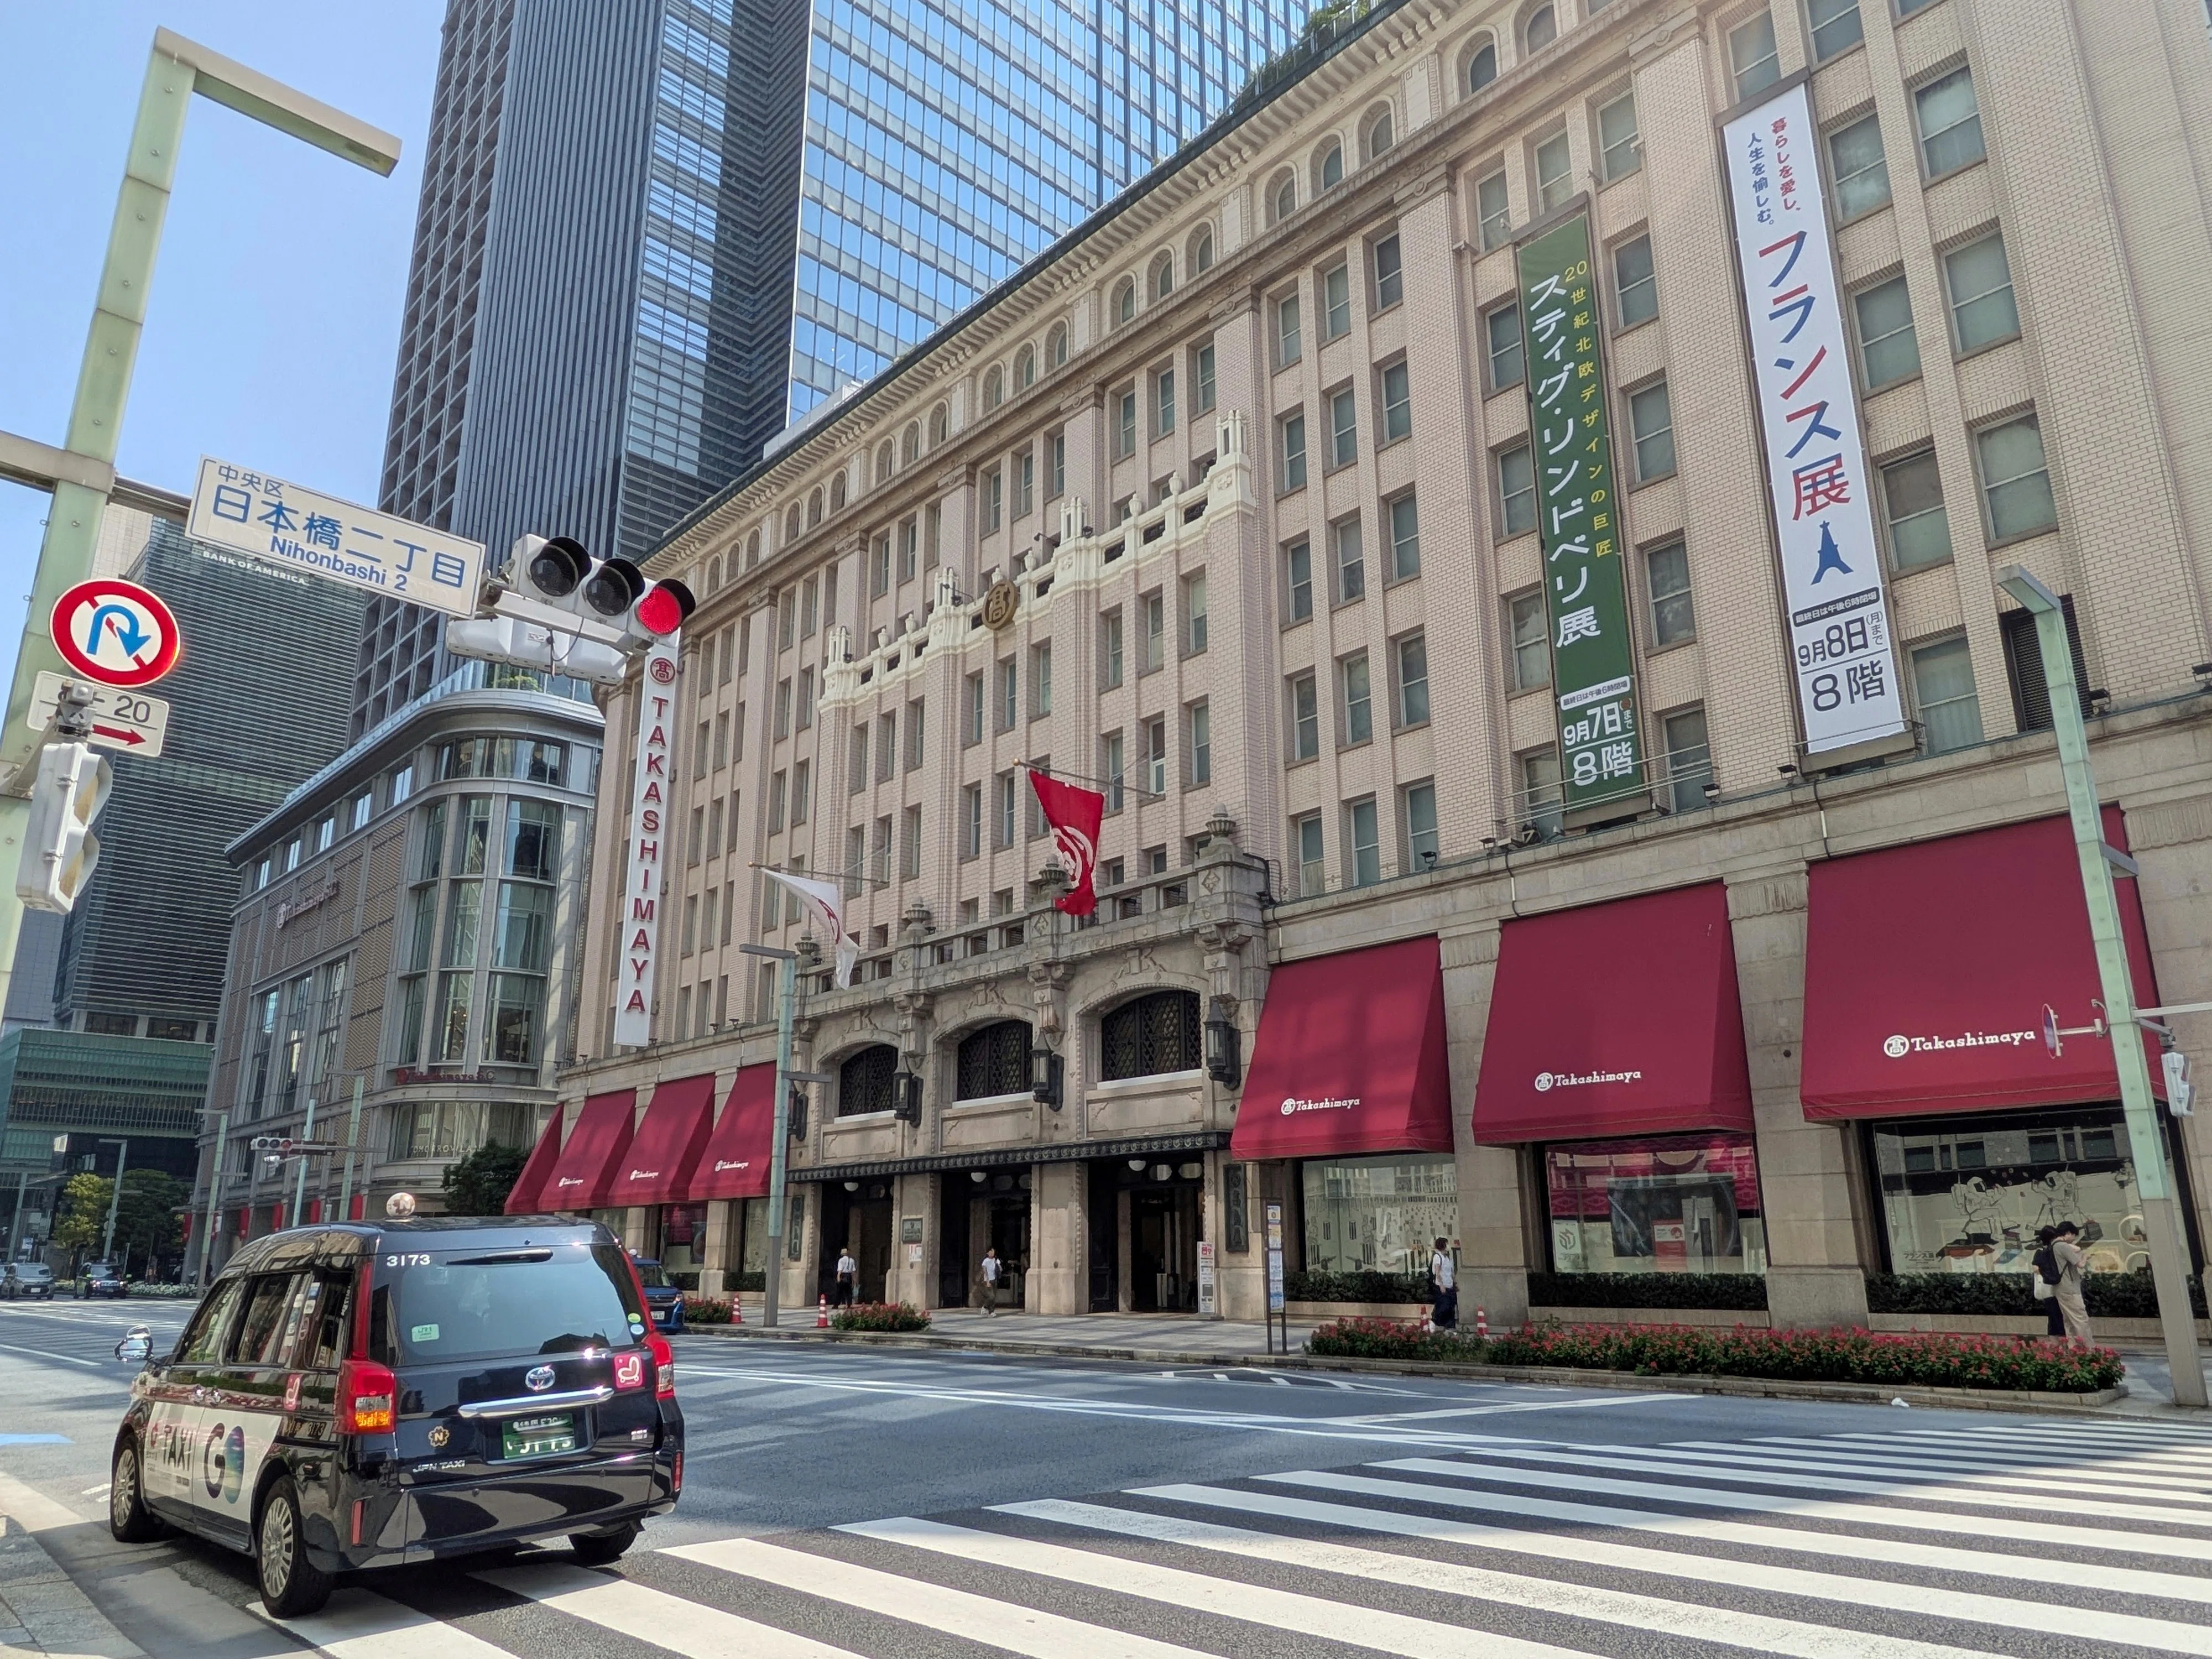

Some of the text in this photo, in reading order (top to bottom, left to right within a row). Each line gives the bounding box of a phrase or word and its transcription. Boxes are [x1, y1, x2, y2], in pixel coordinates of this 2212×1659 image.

[1747, 132, 1774, 225] 人生を愉しむ。
[1759, 230, 1851, 521] フランス展
[1564, 260, 1613, 557] 20世紀北欧デザインの巨匠
[217, 465, 285, 499] 中央区
[1530, 274, 1601, 648] スティグ・リンドベリ展
[212, 484, 466, 589] 日本橋二丁目
[202, 550, 307, 585] BANK OF AMERICA
[269, 535, 408, 592] Nihonbashi 2
[1811, 660, 1885, 712] 8階
[1573, 741, 1633, 786] 8階
[625, 695, 669, 1014] TAKASHIMAYA
[1911, 1030, 2036, 1051] Takashimaya
[1296, 1098, 1360, 1111] Takashimaya
[1554, 1071, 1641, 1087] Takashimaya
[386, 1254, 430, 1267] 3173
